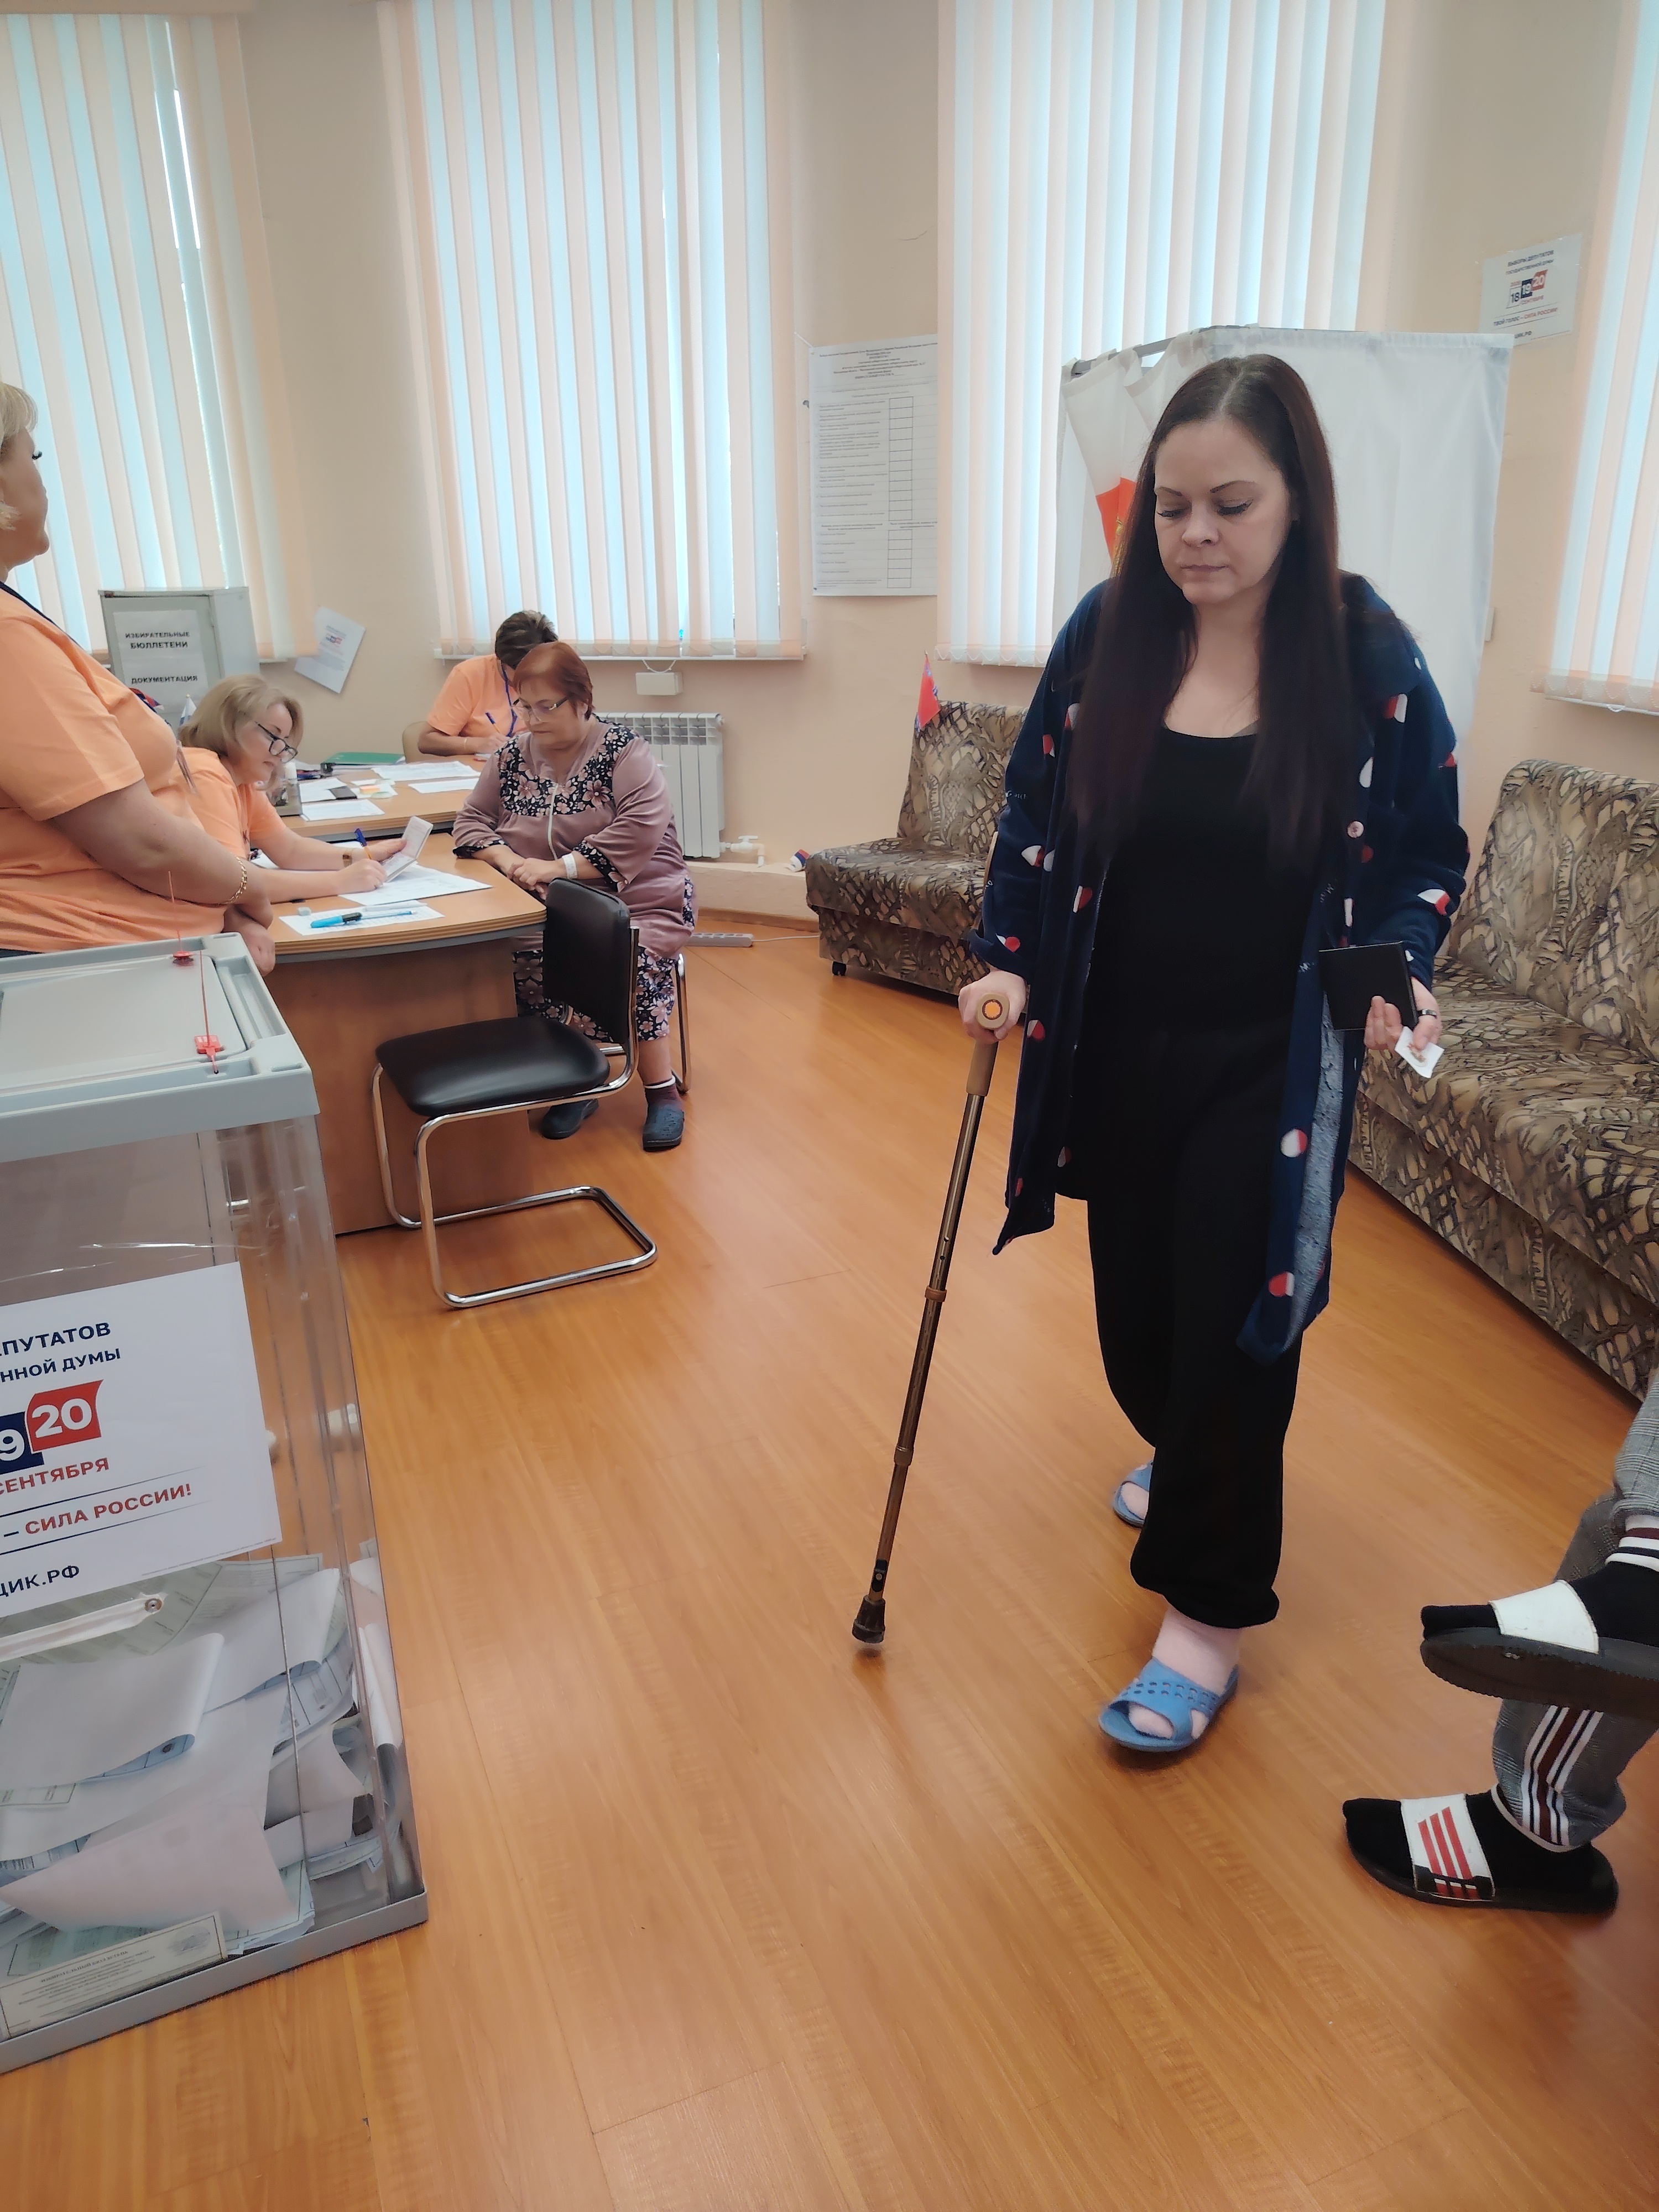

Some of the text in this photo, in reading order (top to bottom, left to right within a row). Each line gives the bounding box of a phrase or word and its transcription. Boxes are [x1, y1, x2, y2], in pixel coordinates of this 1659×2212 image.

[1511, 293, 1520, 303] 18
[1522, 284, 1532, 295] 19
[1532, 275, 1546, 286] 20
[131, 675, 197, 685] ДОКУМЕНТАЦИЯ
[0, 1322, 111, 1355] ПУТАТОВ
[0, 1348, 121, 1383] ННОЙ ДУМЫ
[32, 1398, 92, 1438] 20
[25, 1510, 88, 1534] СИЛА
[93, 1484, 191, 1518] РОССИИ!
